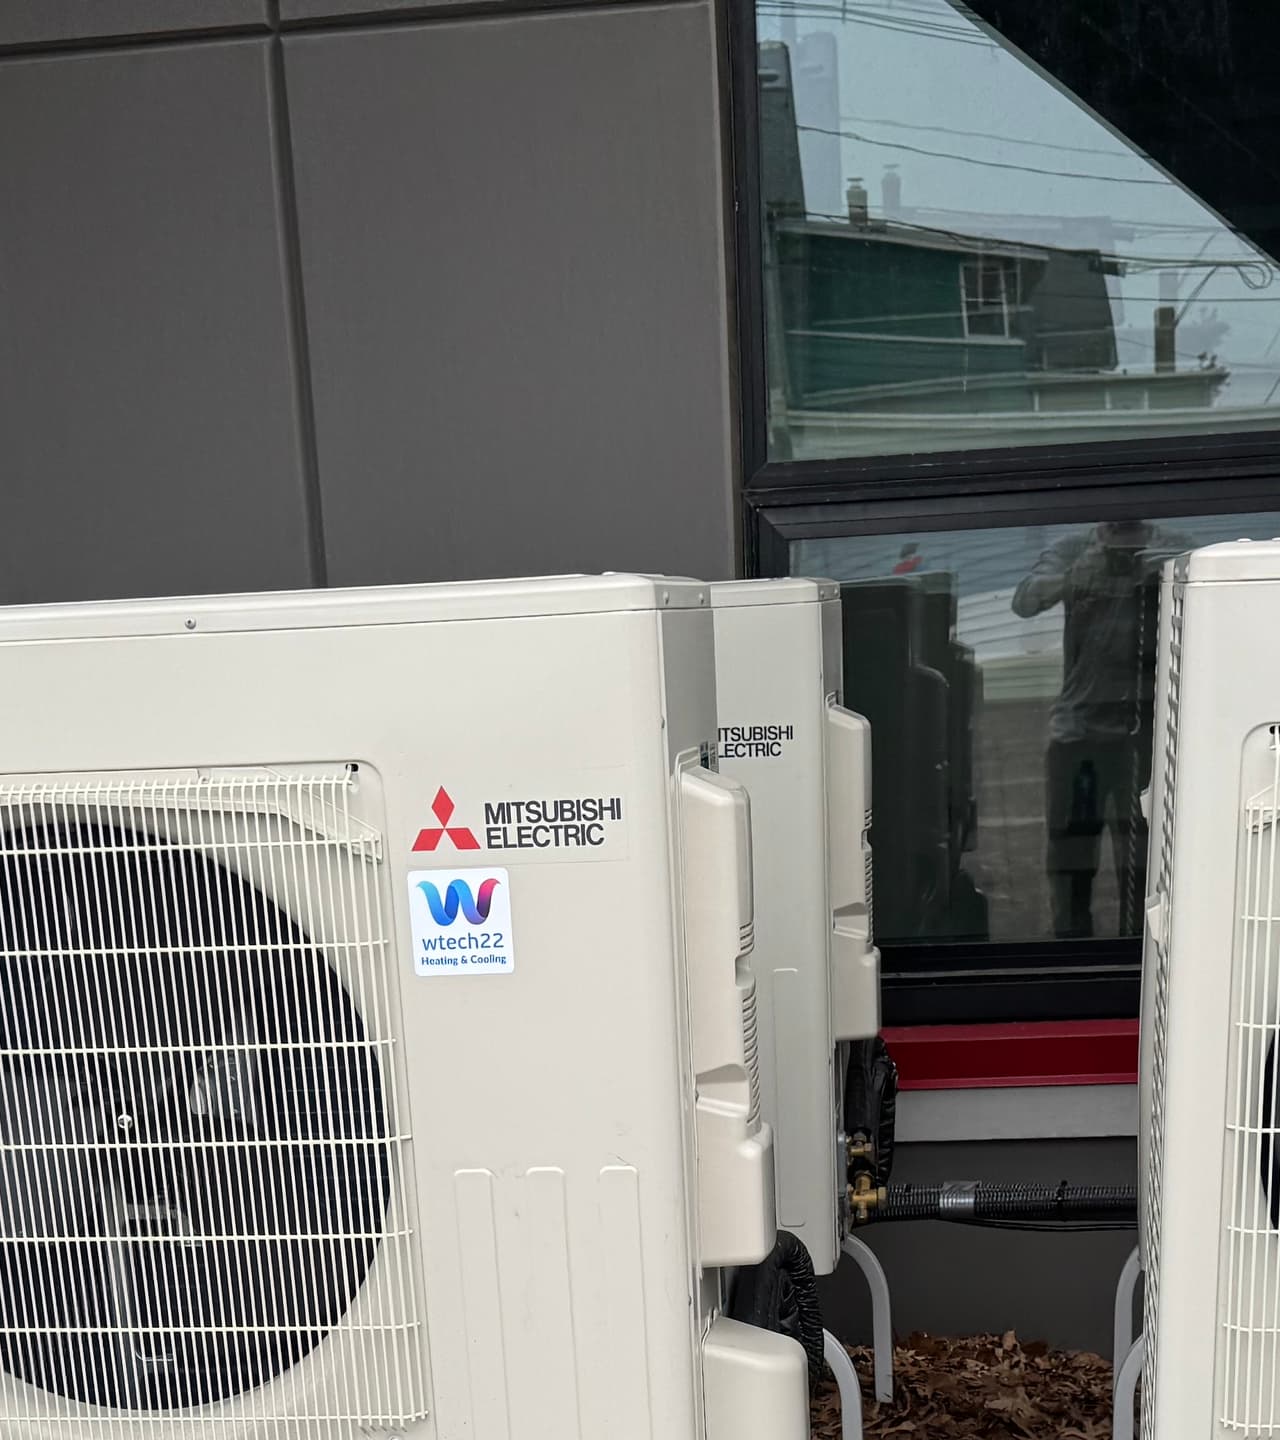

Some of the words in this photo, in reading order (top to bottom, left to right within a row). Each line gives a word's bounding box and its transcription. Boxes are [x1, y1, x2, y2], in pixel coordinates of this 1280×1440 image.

[718, 725, 794, 743] ITSUBISHI
[718, 741, 782, 759] ECTRIC
[484, 797, 622, 825] MITSUBISHI
[486, 823, 605, 849] ELECTRIC
[421, 932, 505, 951] wtech22
[421, 955, 458, 966] Heating
[460, 955, 468, 965] &
[470, 954, 507, 965] Cooling
